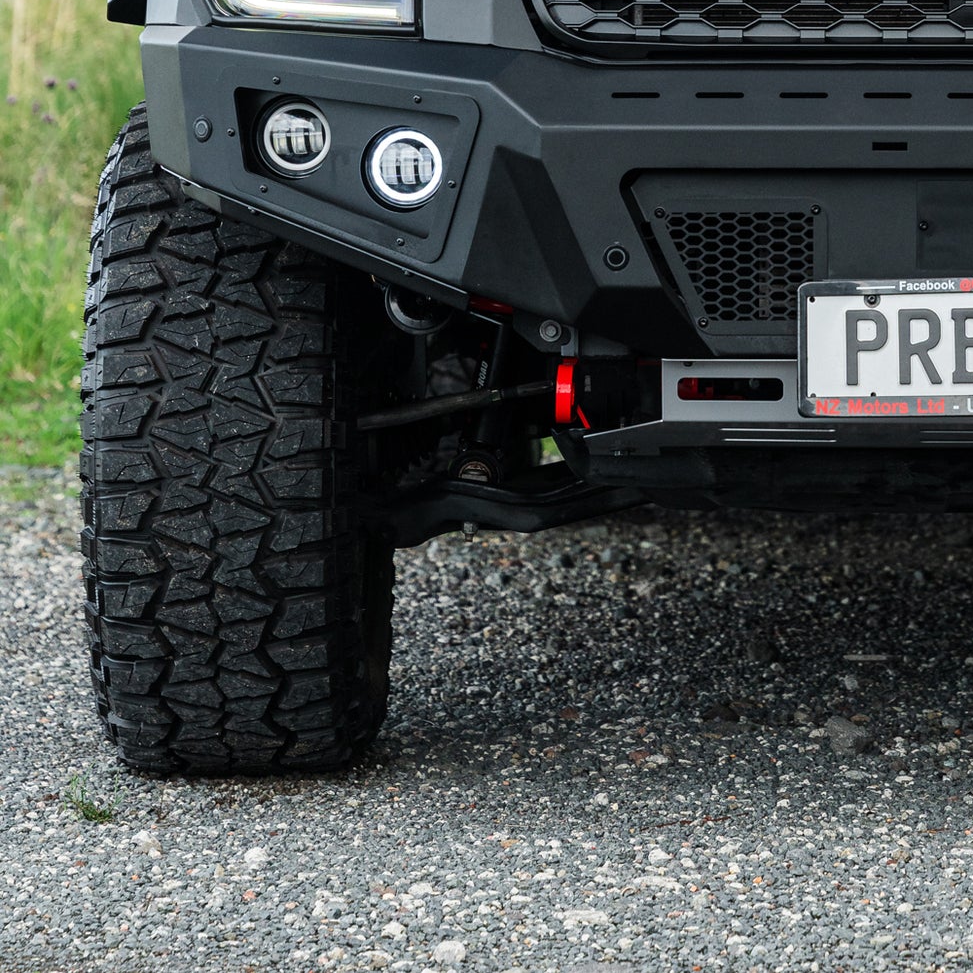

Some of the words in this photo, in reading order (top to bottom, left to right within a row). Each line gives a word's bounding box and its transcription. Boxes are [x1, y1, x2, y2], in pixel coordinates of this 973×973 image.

[899, 280, 955, 291] Facebook
[815, 399, 841, 415] NZ
[848, 399, 909, 415] Motors
[916, 398, 945, 414] Ltd
